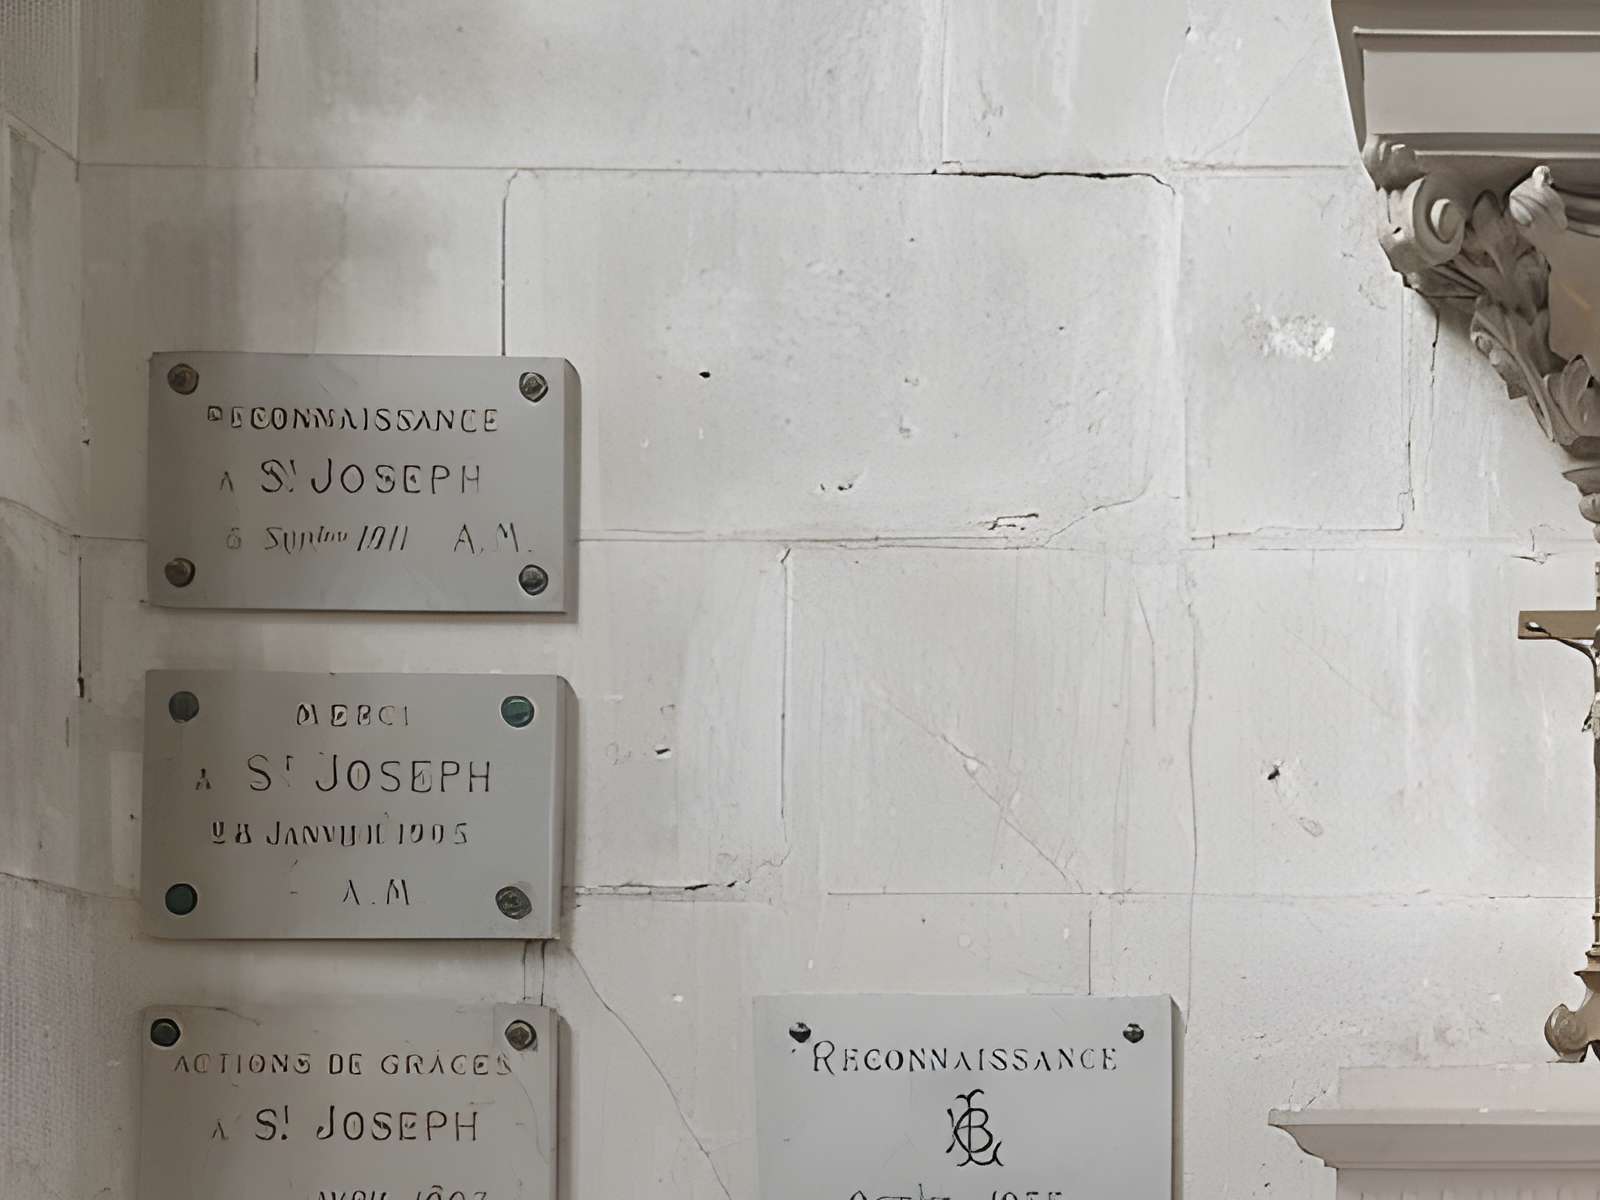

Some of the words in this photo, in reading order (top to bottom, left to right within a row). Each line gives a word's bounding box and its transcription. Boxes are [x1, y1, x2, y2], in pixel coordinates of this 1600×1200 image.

[311, 458, 481, 494] JOSEPH
[296, 704, 409, 727] MERCI
[315, 753, 491, 794] JOSEPH
[174, 1052, 311, 1076] ACTIONS
[329, 1052, 361, 1076] DE
[315, 1105, 478, 1142] JOSEPH
